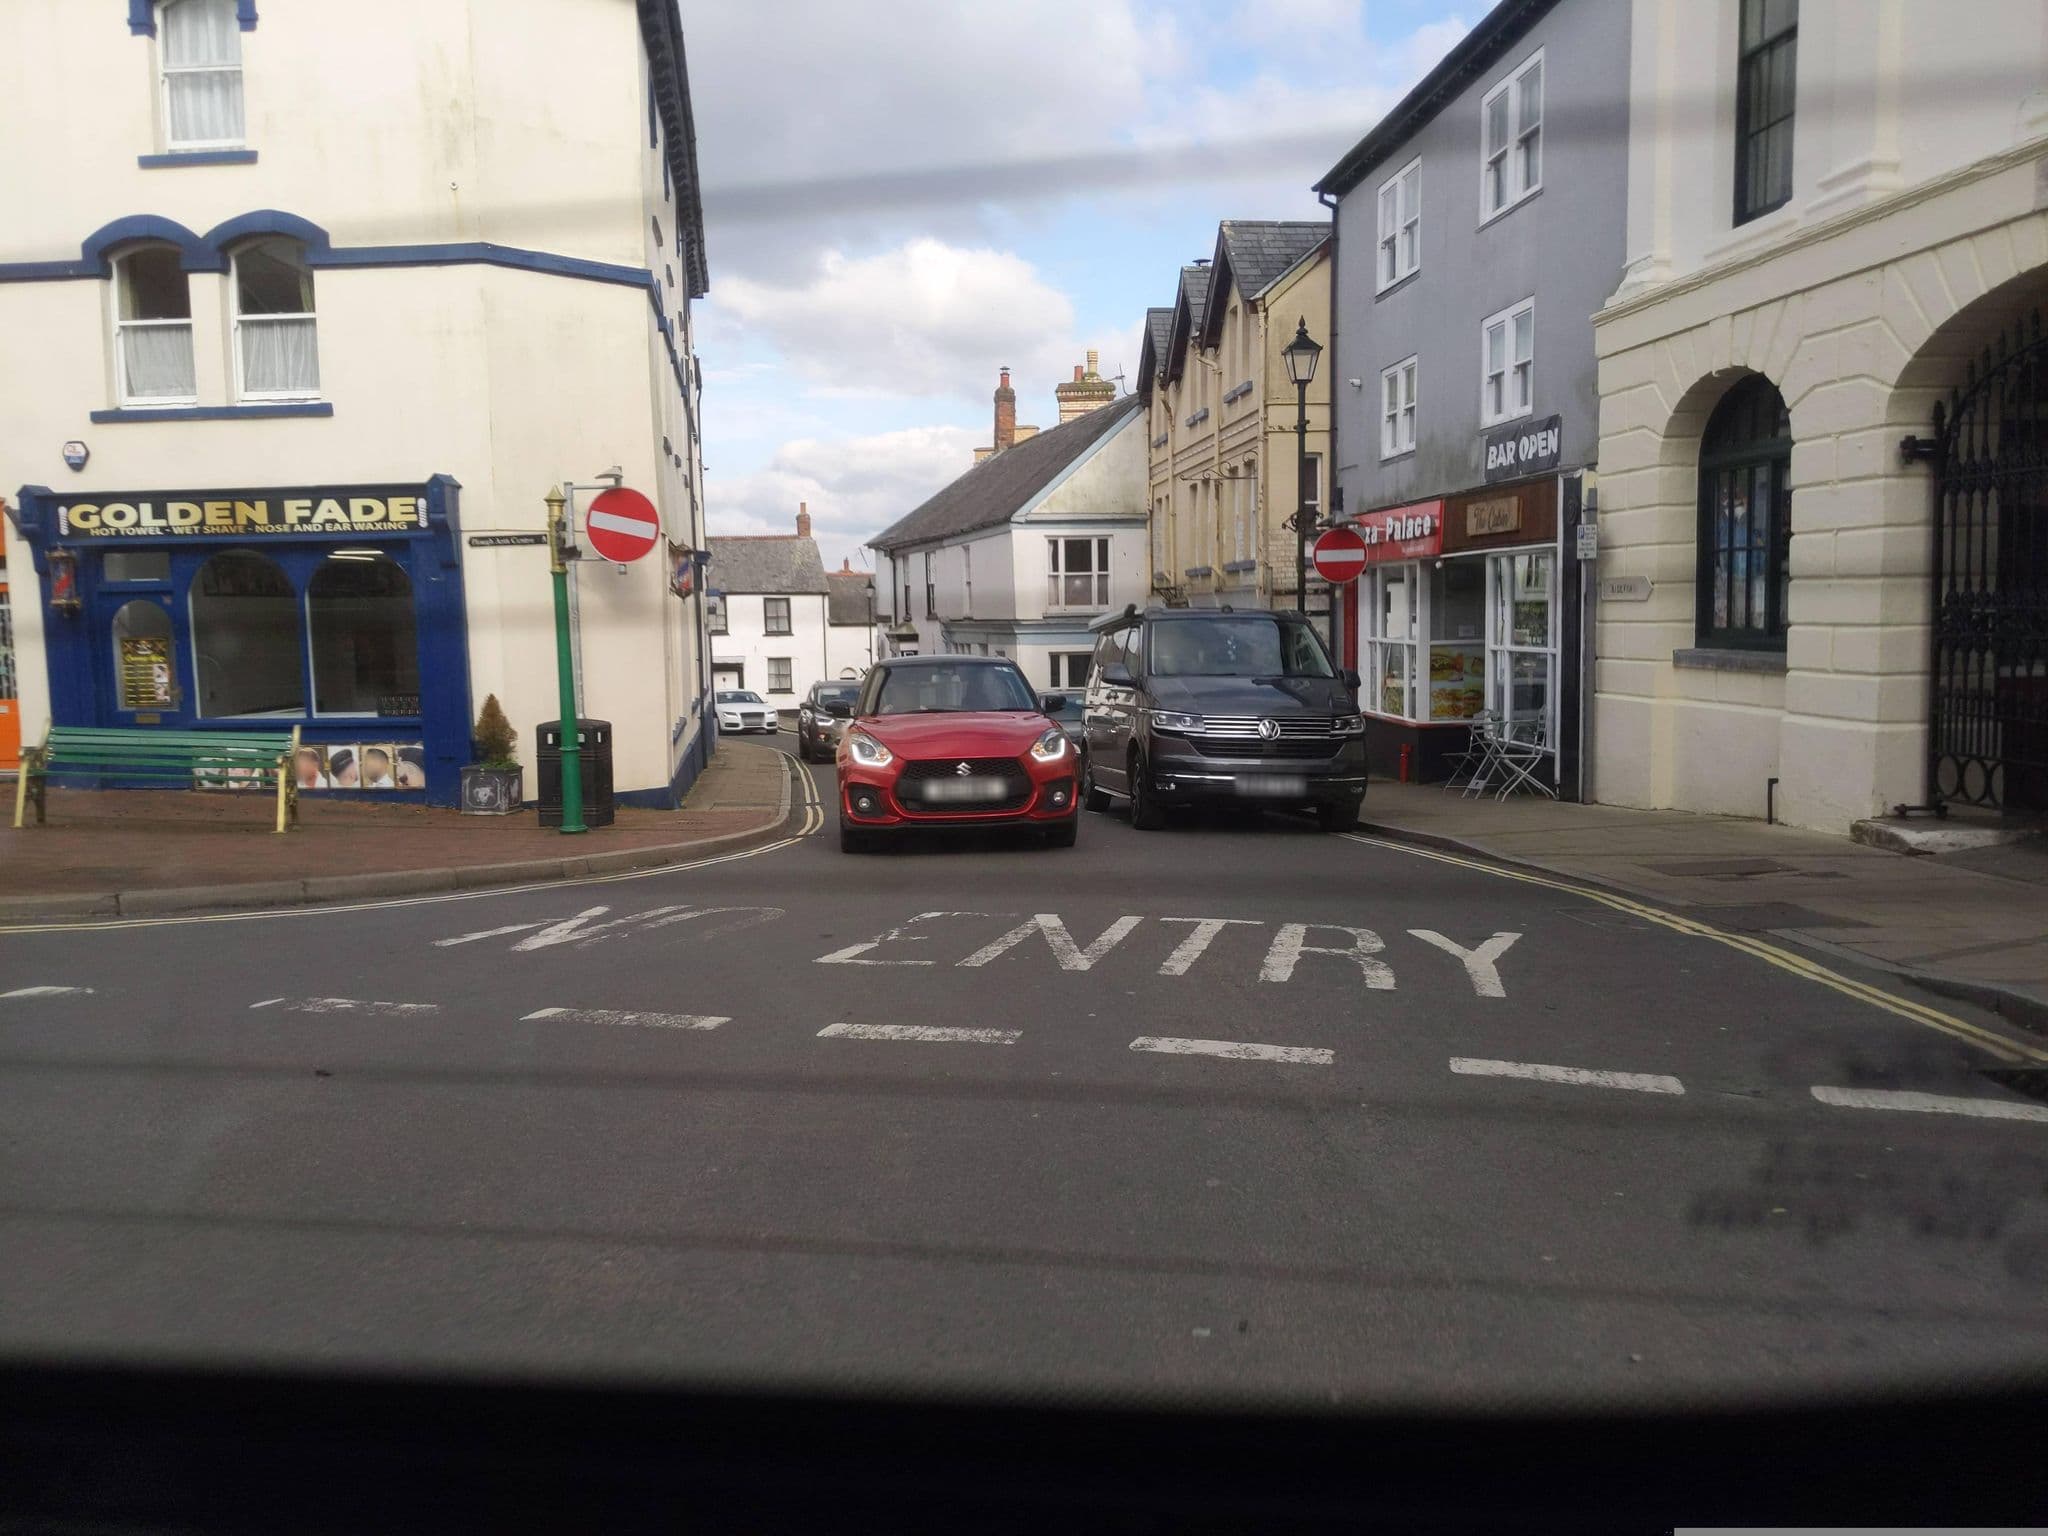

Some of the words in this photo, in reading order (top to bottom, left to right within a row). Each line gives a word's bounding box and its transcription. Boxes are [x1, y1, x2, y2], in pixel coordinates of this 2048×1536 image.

[1487, 441, 1516, 469] BAR
[1519, 427, 1559, 462] OPEN
[68, 501, 269, 529] GOLDEN
[284, 497, 418, 524] FADE
[90, 528, 117, 536] HOT
[119, 527, 164, 536] TOWEL
[172, 526, 200, 535] WET
[203, 525, 245, 534] SHAVE
[255, 524, 291, 533] NOSE
[293, 523, 323, 532] AND
[325, 522, 352, 532] EAR
[353, 521, 408, 531] WAXING
[1386, 513, 1431, 542] Palace
[433, 904, 786, 952] NO
[812, 911, 1523, 998] ENTRY
